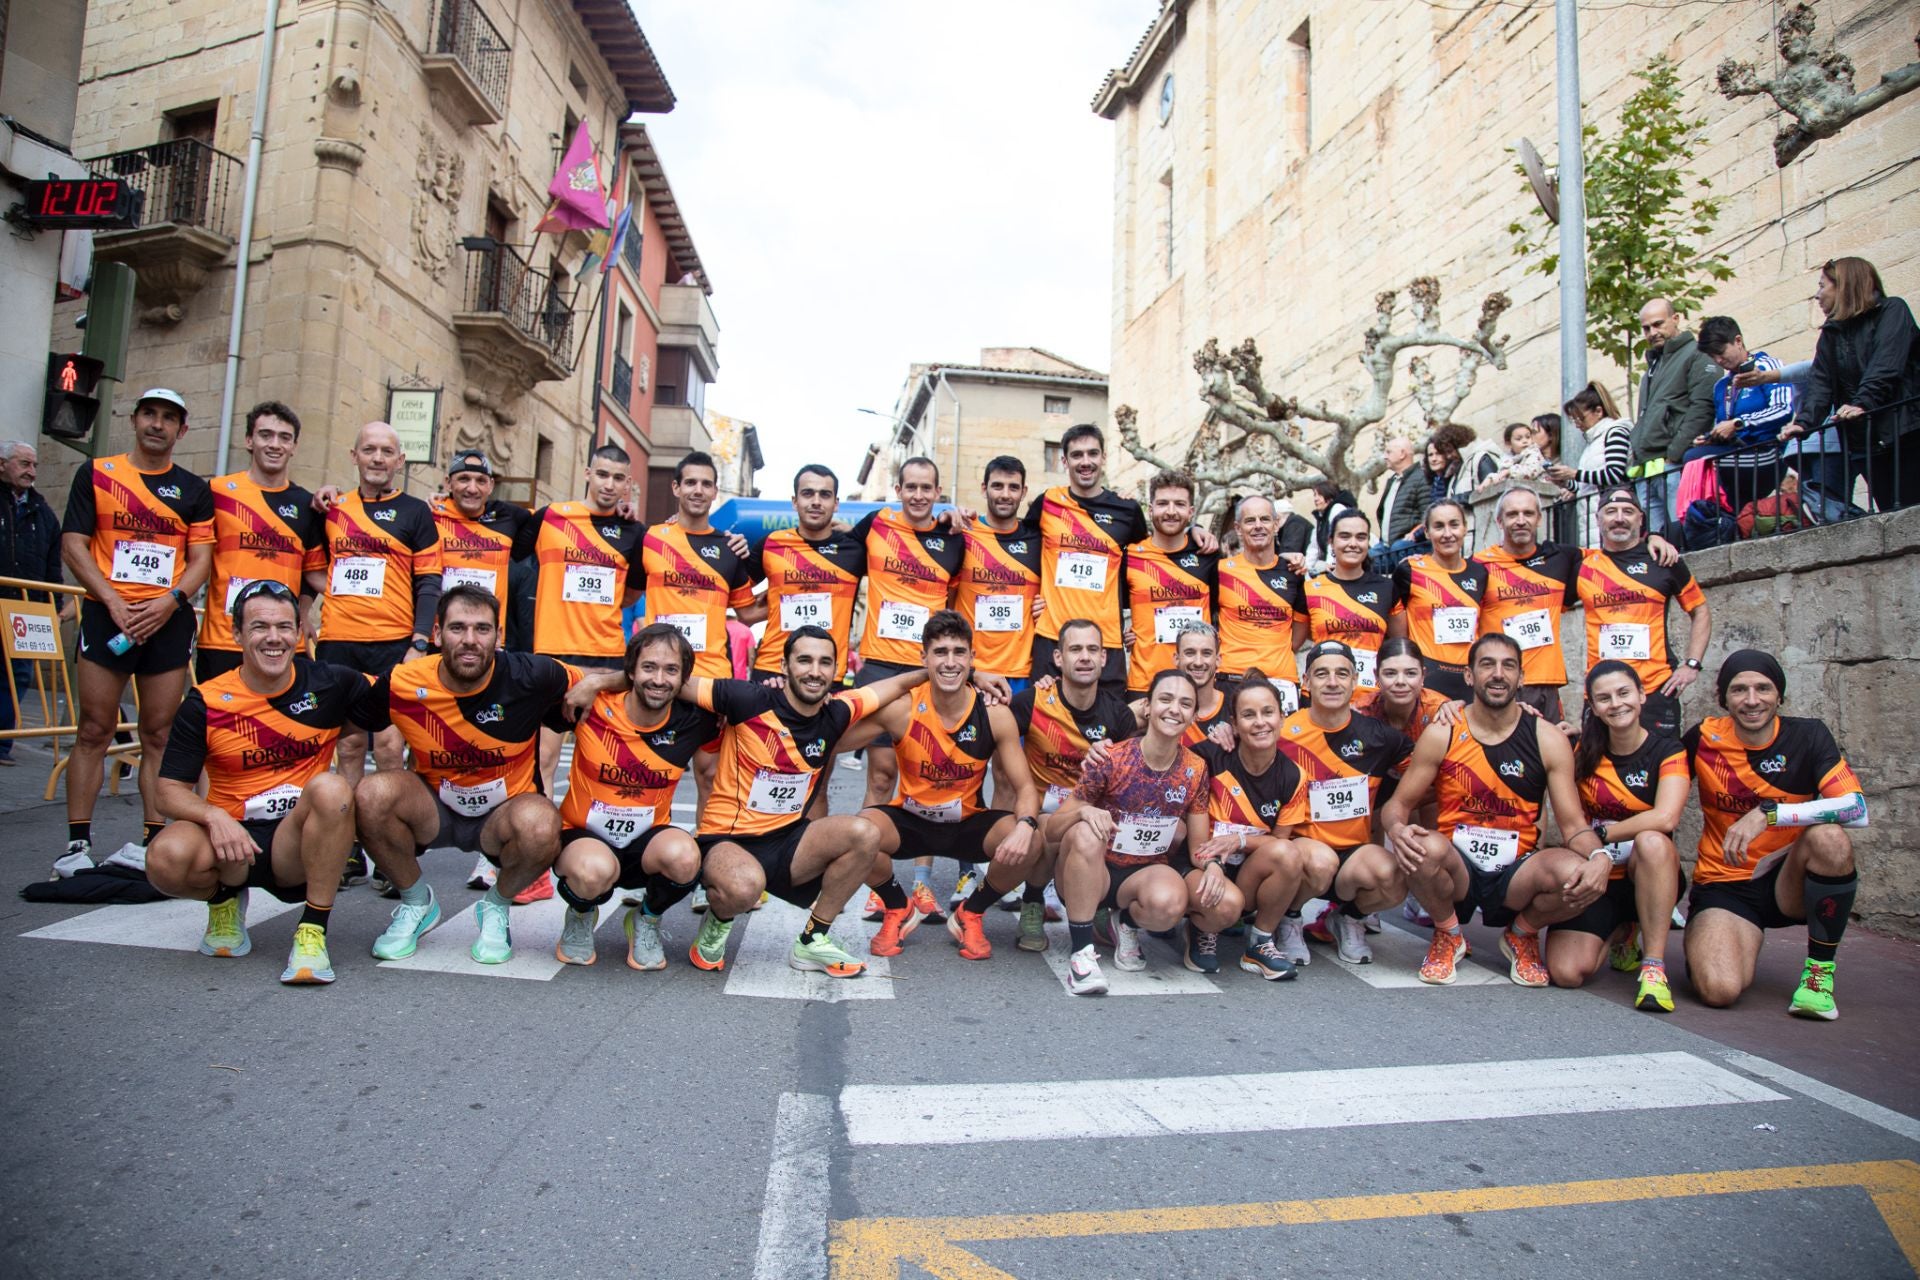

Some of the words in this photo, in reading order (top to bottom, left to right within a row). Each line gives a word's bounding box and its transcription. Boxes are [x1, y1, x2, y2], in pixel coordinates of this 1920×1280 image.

[113, 511, 177, 533] FORONDA
[117, 542, 128, 551] 18
[239, 532, 296, 549] FORONDA
[335, 536, 391, 552] FORONDA
[444, 536, 502, 549] FORONDA
[1060, 533, 1110, 551] FORONDA
[131, 554, 160, 569] 448
[563, 546, 617, 564] FORONDA
[884, 556, 937, 578] FORONDA
[1070, 563, 1093, 576] 418
[232, 577, 242, 586] 18
[344, 569, 368, 581] 488
[664, 570, 717, 589] FORONDA
[784, 569, 838, 582] FORONDA
[972, 567, 1026, 582] FORONDA
[578, 577, 602, 590] 393
[1497, 582, 1550, 598] FORONDA
[365, 587, 380, 595] SDi
[1150, 584, 1201, 599] FORONDA
[1593, 590, 1647, 605] FORONDA
[795, 605, 817, 618] 419
[989, 606, 1011, 618] 385
[891, 614, 915, 627] 396
[1325, 618, 1380, 632] FORONDA
[1448, 618, 1469, 630] 335
[28, 623, 52, 634] RISER
[1519, 622, 1541, 636] 386
[16, 640, 29, 650] 941
[39, 642, 46, 651] 13
[1610, 634, 1634, 647] 357
[242, 735, 320, 766] FORONDA
[430, 747, 505, 766] FORONDA
[600, 763, 671, 785] FORONDA
[759, 770, 768, 780] 18
[920, 760, 975, 778] FORONDA
[768, 787, 796, 799] 422
[1327, 790, 1353, 805] 394
[266, 796, 299, 814] 336
[457, 795, 488, 806] 348
[1353, 807, 1367, 816] SDi
[604, 819, 635, 833] 478
[1123, 815, 1133, 824] 18
[1133, 829, 1161, 842] 392
[1469, 840, 1499, 856] 345
